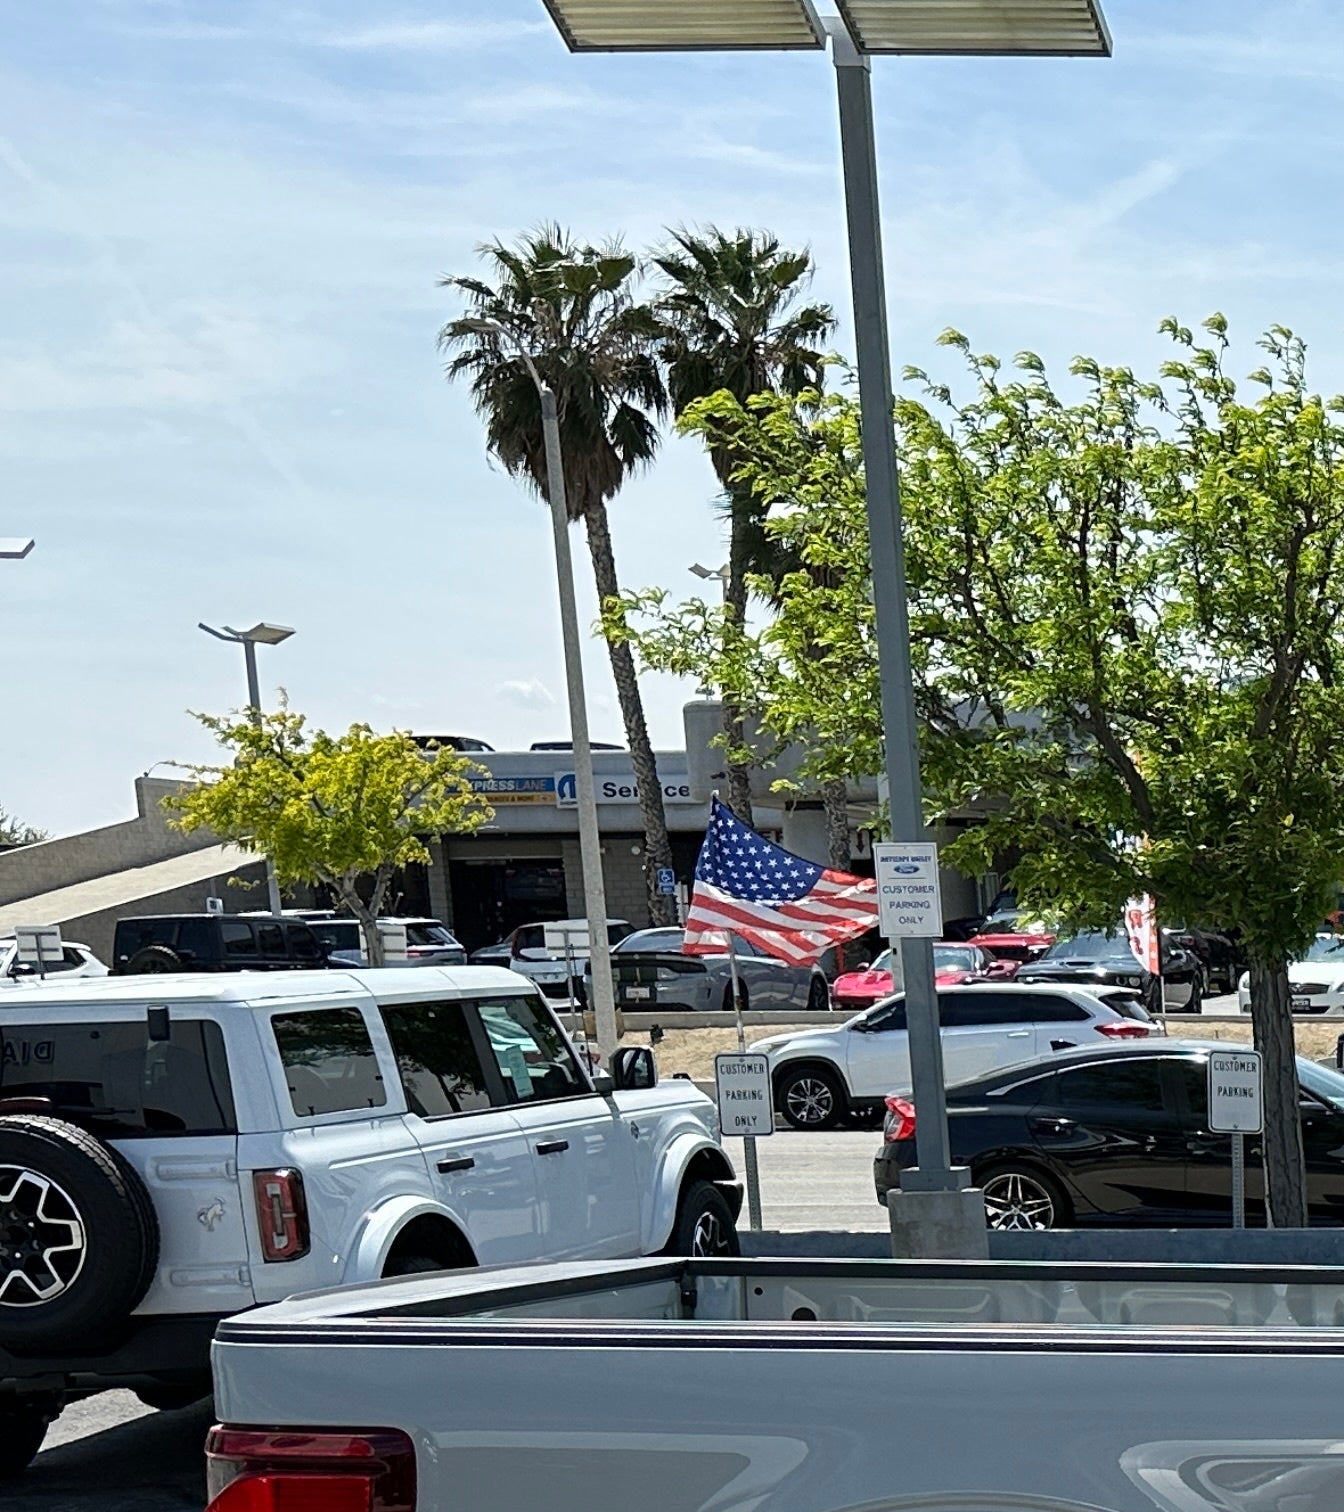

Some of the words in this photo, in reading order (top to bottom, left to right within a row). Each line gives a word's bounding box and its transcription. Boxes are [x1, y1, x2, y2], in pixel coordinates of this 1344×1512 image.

[603, 782, 690, 798] Serce
[882, 885, 935, 894] CUSTOMER
[889, 901, 931, 909] PARKING
[898, 916, 924, 925] ONLY
[720, 1063, 764, 1075] CUSTOMER
[1214, 1060, 1257, 1073] CUSTOMER
[726, 1089, 763, 1100] PARKING
[1217, 1085, 1254, 1098] PARKING
[735, 1115, 757, 1127] ONLY
